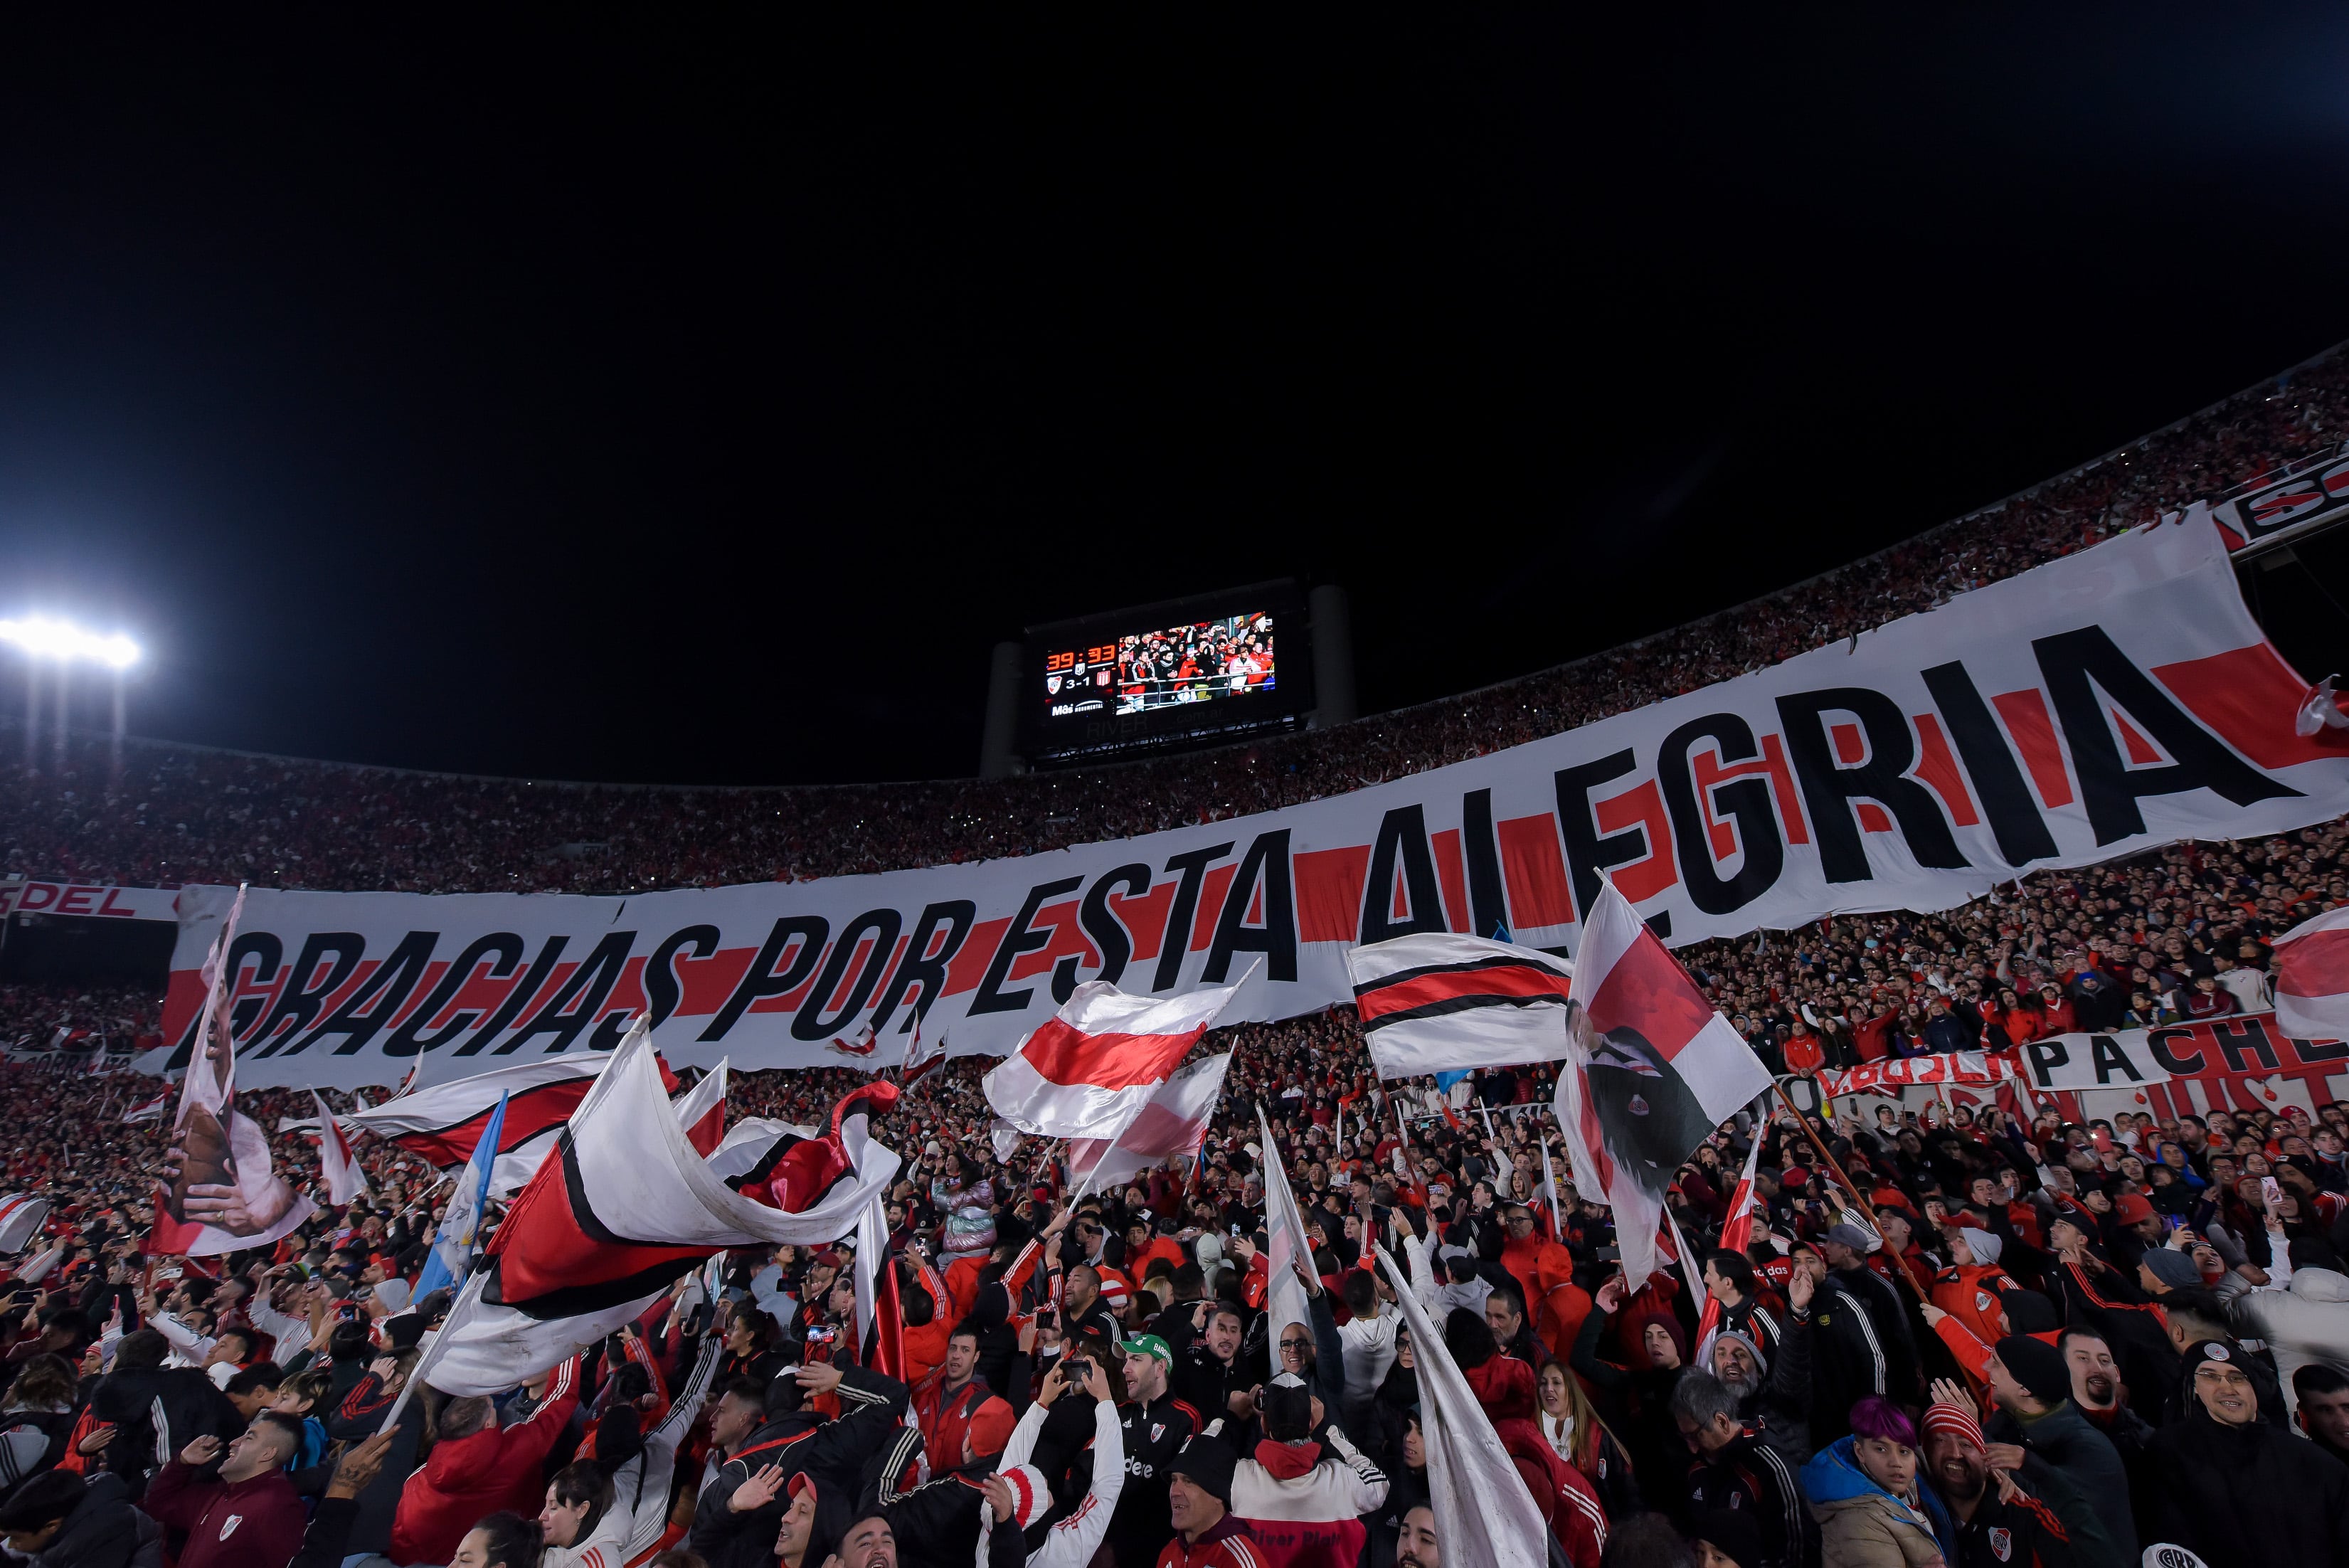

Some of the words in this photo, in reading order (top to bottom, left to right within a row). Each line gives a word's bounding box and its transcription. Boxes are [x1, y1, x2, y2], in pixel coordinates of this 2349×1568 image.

[1066, 676, 1090, 689] 3-1
[165, 923, 720, 1071] GRACIAS
[695, 899, 976, 1042] POR
[966, 828, 1298, 1018] ESTA
[1359, 623, 2308, 958] ALEGRIA
[18, 882, 135, 916] DEL
[1124, 1455, 1153, 1479] dere
